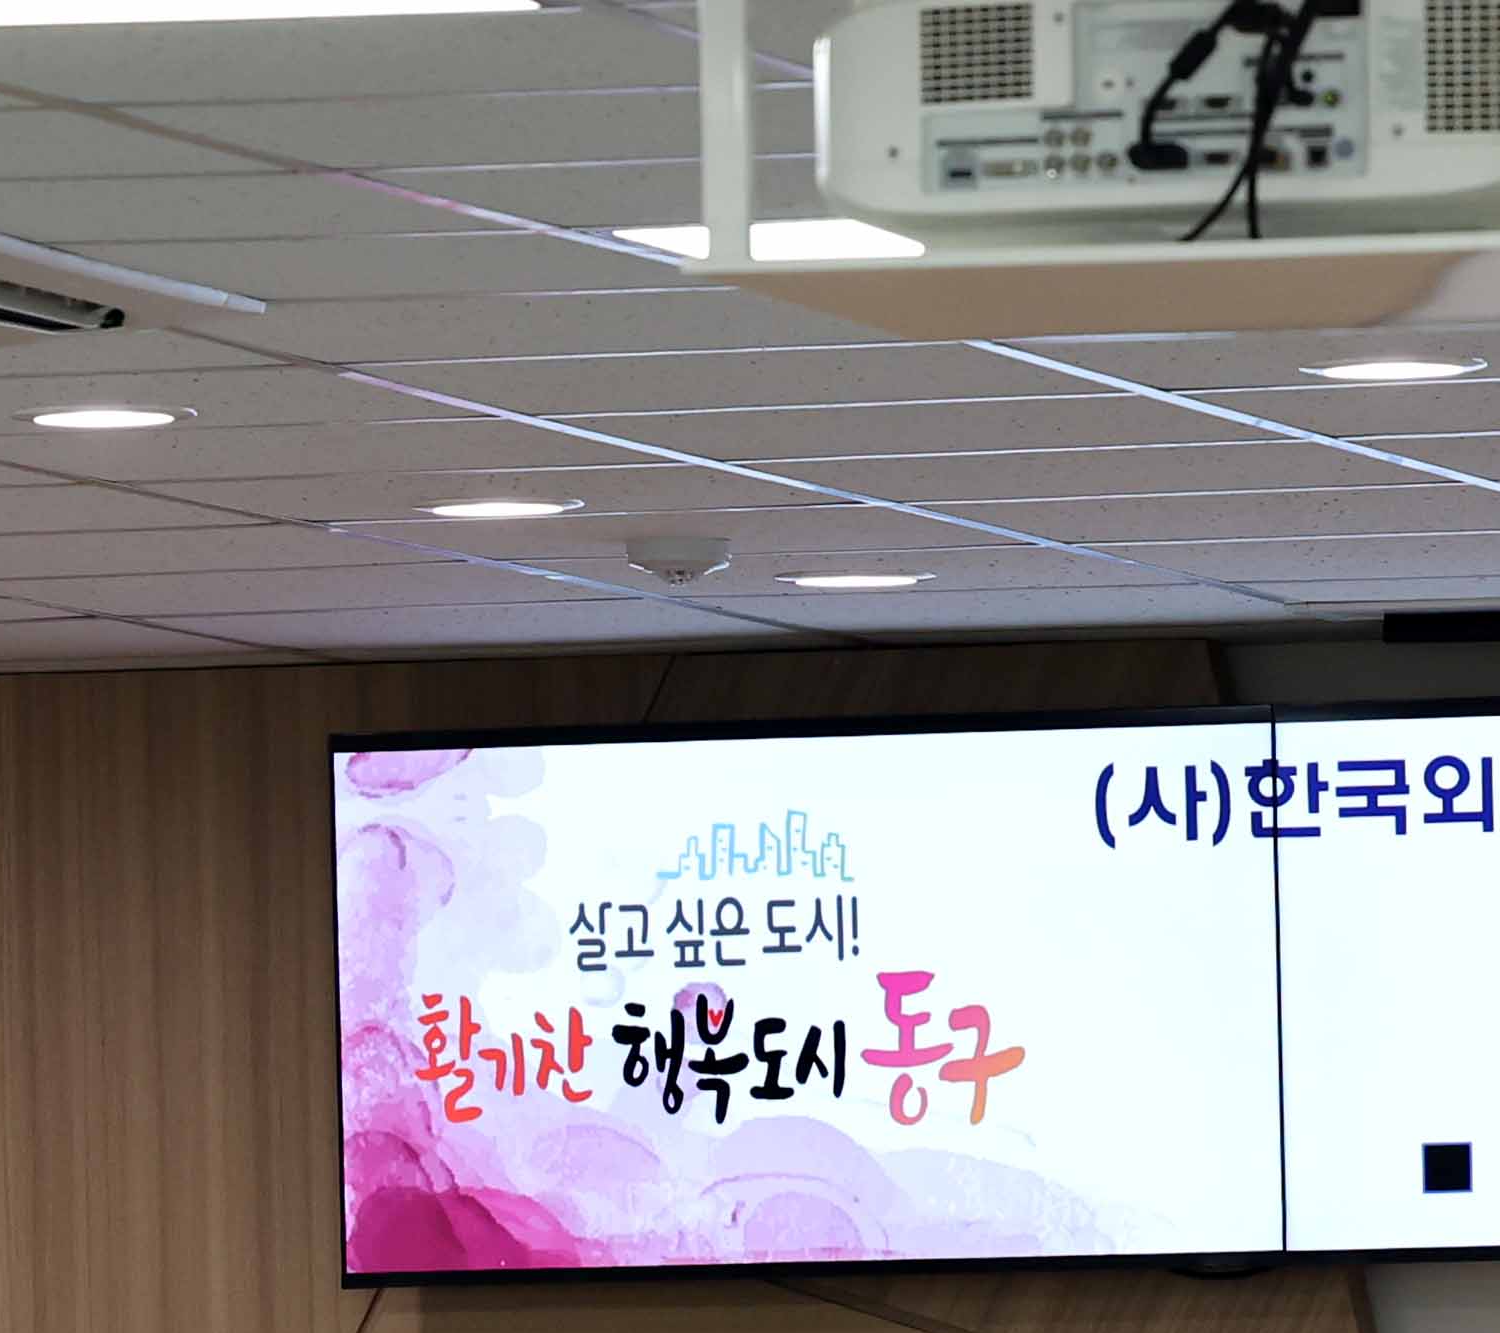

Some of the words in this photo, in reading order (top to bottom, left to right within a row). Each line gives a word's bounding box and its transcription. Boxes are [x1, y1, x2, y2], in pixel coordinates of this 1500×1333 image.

[569, 901, 655, 972] 살고
[666, 897, 750, 968] 싶은
[762, 894, 859, 961] 도시!
[414, 993, 593, 1124] 활기찬
[611, 993, 846, 1124] 행복도시
[861, 970, 1025, 1126] 동구
